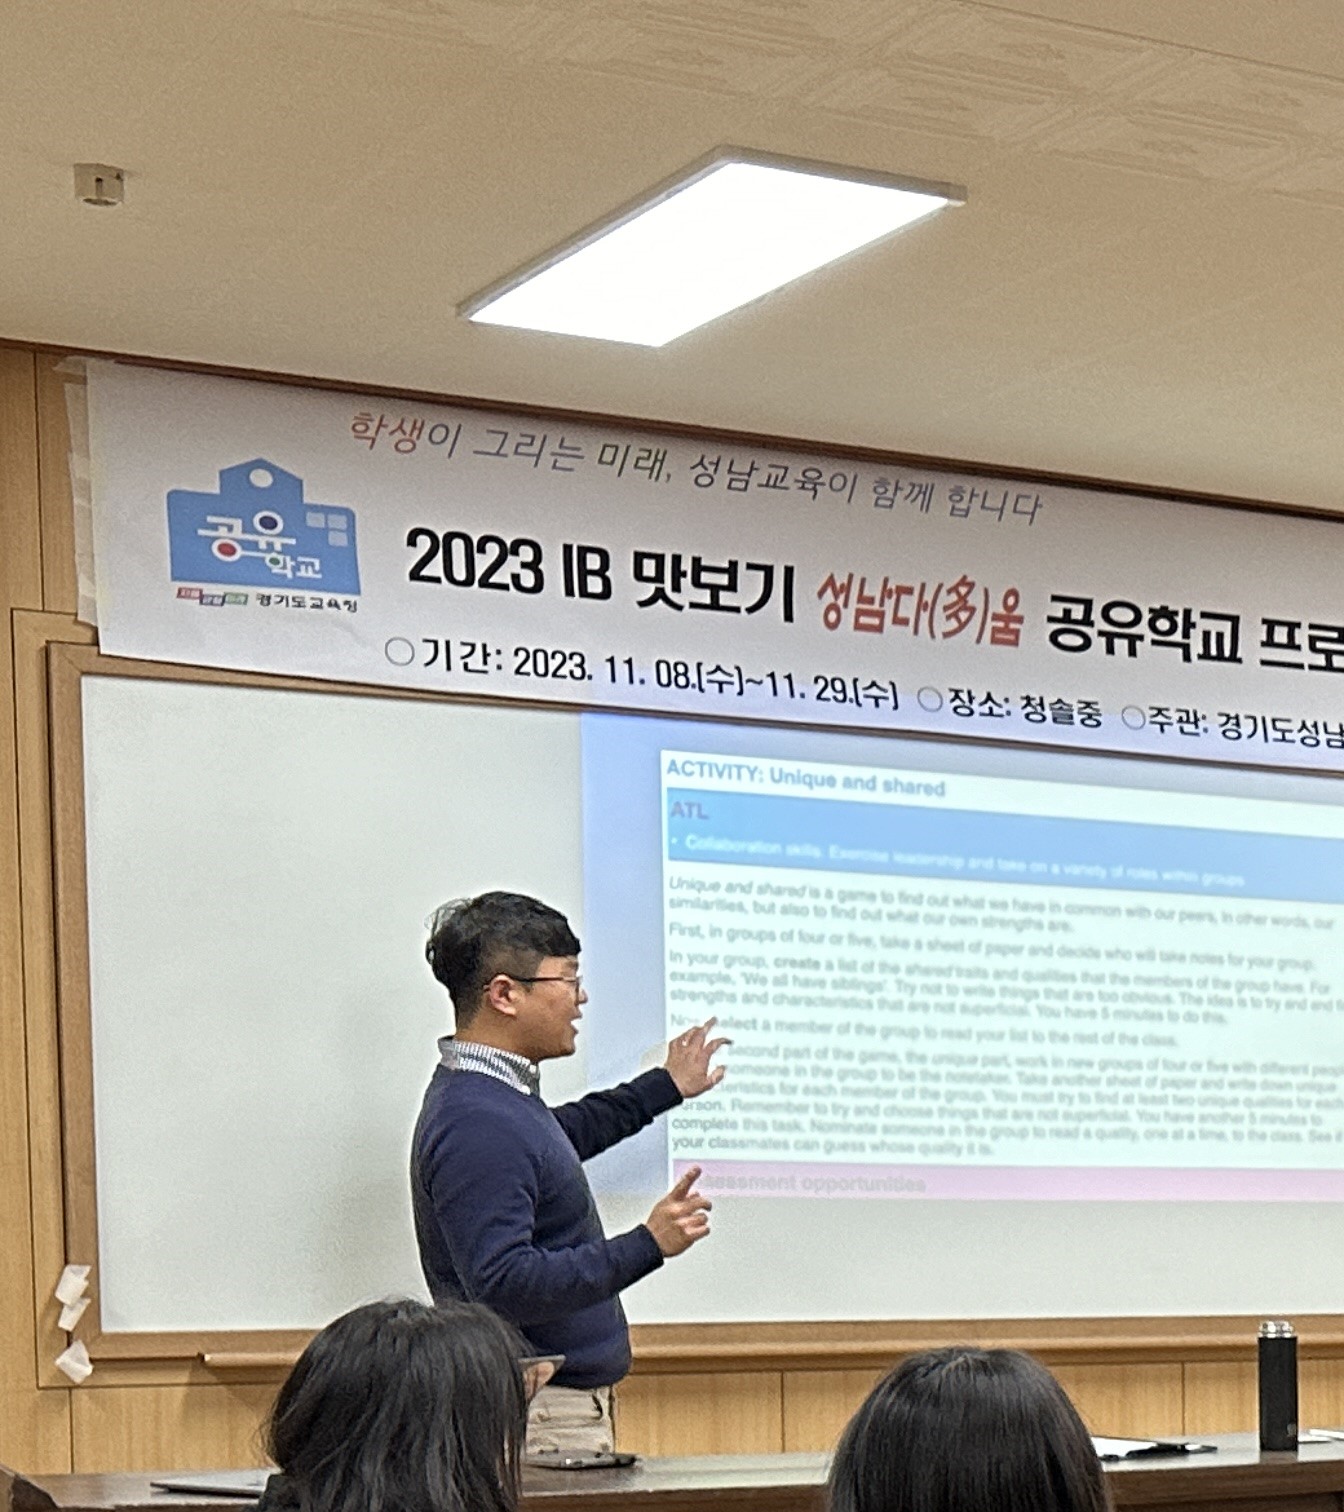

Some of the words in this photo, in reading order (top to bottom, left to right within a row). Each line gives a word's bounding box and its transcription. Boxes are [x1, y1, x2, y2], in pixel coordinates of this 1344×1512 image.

[352, 412, 461, 458] 학생이
[473, 429, 585, 472] 그리는
[598, 442, 671, 483] 미래,
[690, 454, 857, 503] 성남교육이
[872, 477, 935, 514] 함께
[948, 485, 1042, 525] 합니다
[406, 527, 544, 595] 2023
[562, 543, 611, 600] IB
[632, 550, 794, 623] 맛보기
[817, 572, 1025, 647] 성남다(多)움
[1046, 594, 1243, 665] 공유학교
[421, 637, 503, 675] 기간:
[513, 647, 594, 681] 2023.
[604, 655, 646, 686] 11.
[948, 687, 1012, 718] 장소:
[1020, 694, 1103, 729] 청솔중
[1148, 705, 1208, 736] 주관:
[666, 758, 764, 779] ACTIVITY:
[769, 768, 836, 788] Unique
[842, 775, 877, 791] and
[883, 778, 946, 797] shared
[670, 801, 709, 820] ATL
[801, 1175, 926, 1195] opportunities
